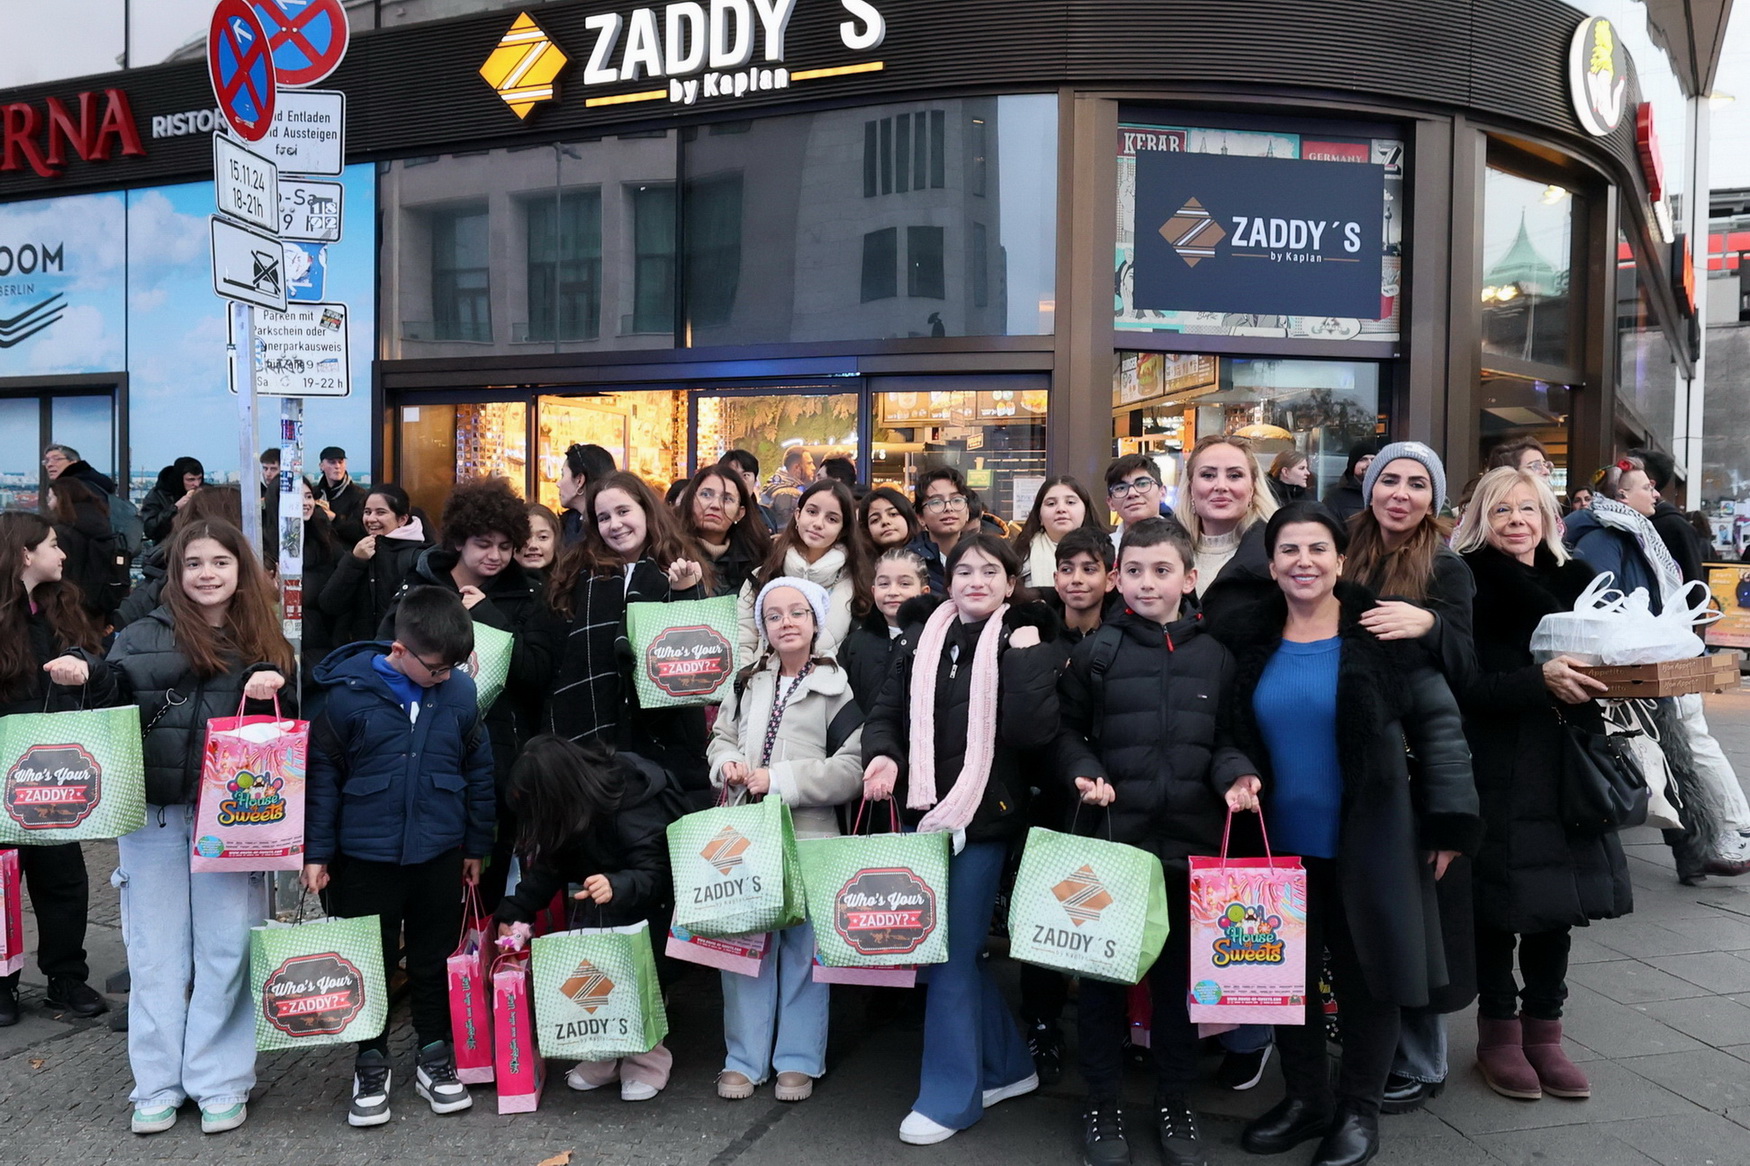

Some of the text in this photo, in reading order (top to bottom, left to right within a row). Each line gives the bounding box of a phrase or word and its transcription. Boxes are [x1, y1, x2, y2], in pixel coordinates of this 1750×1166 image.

[669, 67, 791, 105] by Kaplan
[287, 110, 331, 123] Entladen
[283, 126, 338, 143] Aussteigen
[1308, 152, 1362, 163] GERMANY
[229, 158, 265, 192] 15.11.24
[233, 187, 264, 218] 18-21h
[1270, 251, 1322, 263] by Kaplan
[263, 310, 296, 321] Parken
[299, 311, 314, 321] mit
[306, 327, 326, 336] oder
[306, 360, 314, 370] 9
[303, 377, 334, 388] 19-22
[338, 377, 343, 388] h
[654, 644, 723, 660] Who's Your
[668, 661, 711, 674] ZADDY?
[14, 767, 91, 785] Who's Your
[25, 788, 75, 802] ZADDY?
[234, 790, 278, 809] House
[219, 800, 285, 824] Sweets
[843, 891, 925, 911] Who's Your
[859, 914, 910, 928] ZADDY?
[1227, 926, 1274, 946] House
[1214, 939, 1283, 965] Sweets
[271, 975, 353, 997] Who's Your
[288, 996, 339, 1013] ZADDY?
